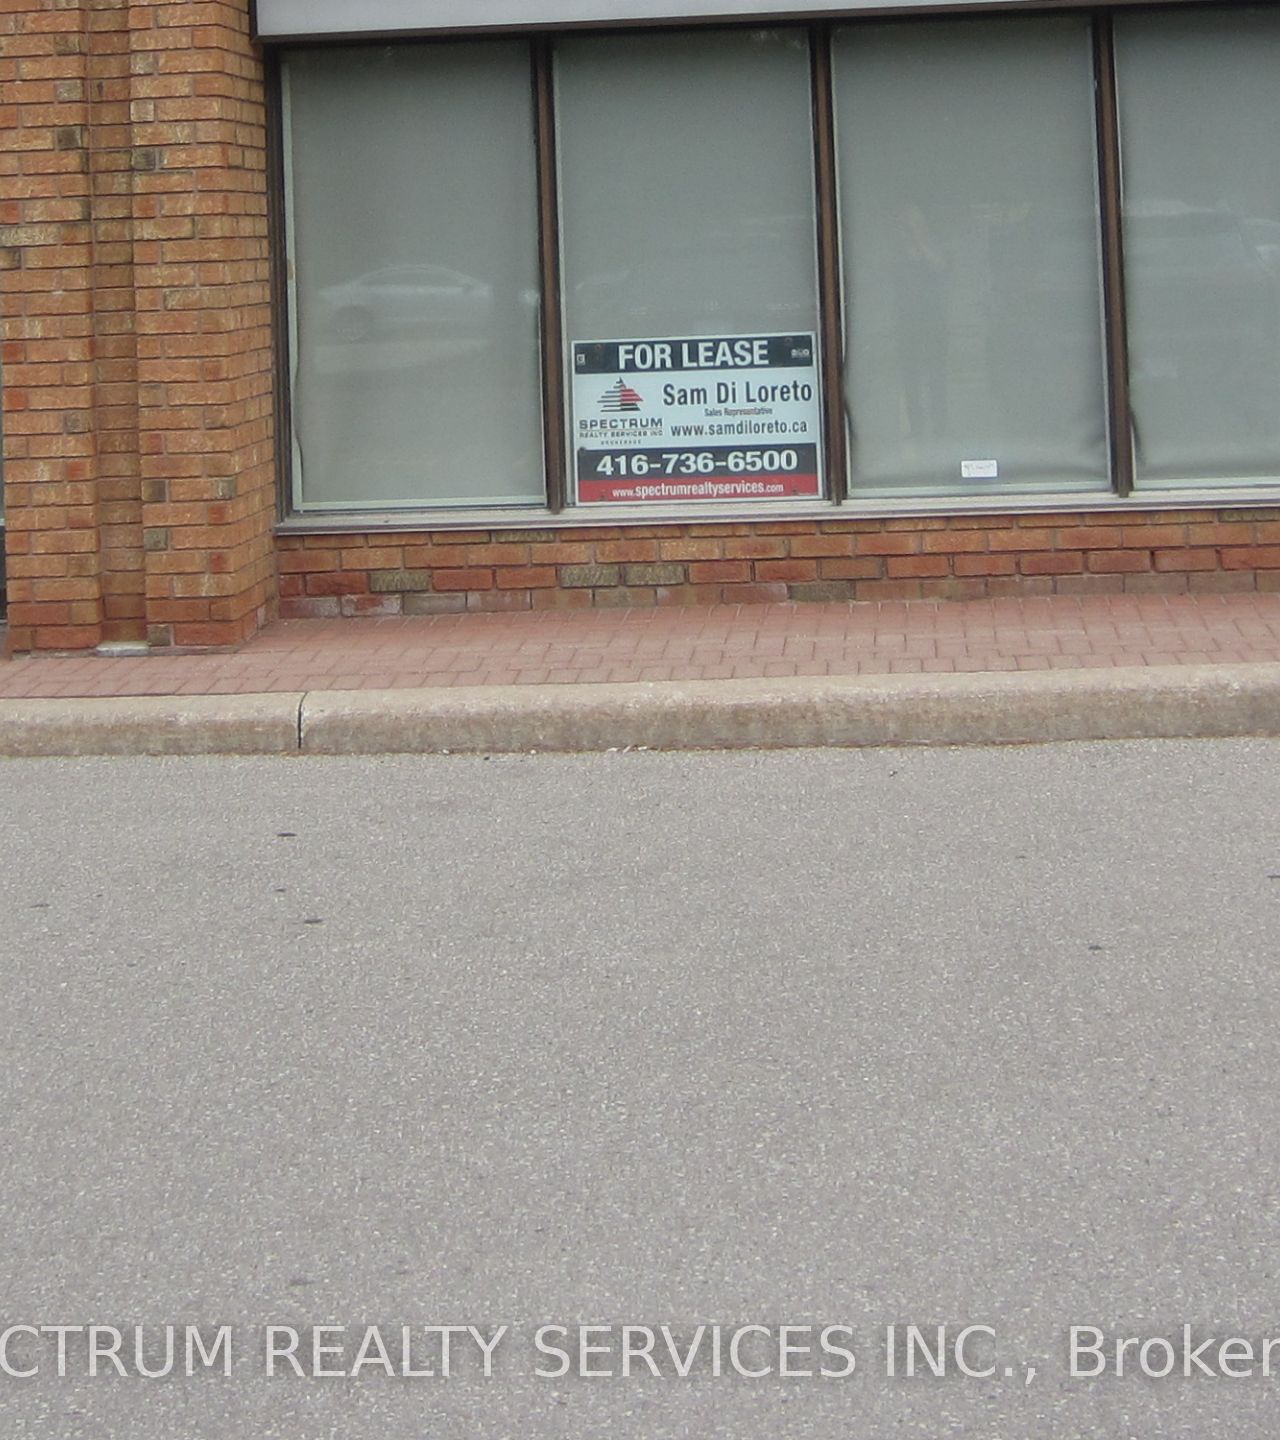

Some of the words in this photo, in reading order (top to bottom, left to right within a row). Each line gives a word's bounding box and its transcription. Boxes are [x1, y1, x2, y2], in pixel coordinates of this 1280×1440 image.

[619, 344, 672, 370] FOR
[682, 339, 770, 368] LEASE
[663, 383, 707, 406] Sam
[716, 381, 736, 404] Di
[745, 379, 813, 403] Loreto
[579, 417, 663, 430] SPECTRUM
[670, 419, 808, 438] www.samdiloreto.ca
[596, 449, 799, 476] 416-736-6500
[612, 480, 785, 499] www.spectrumrealtyservices.com
